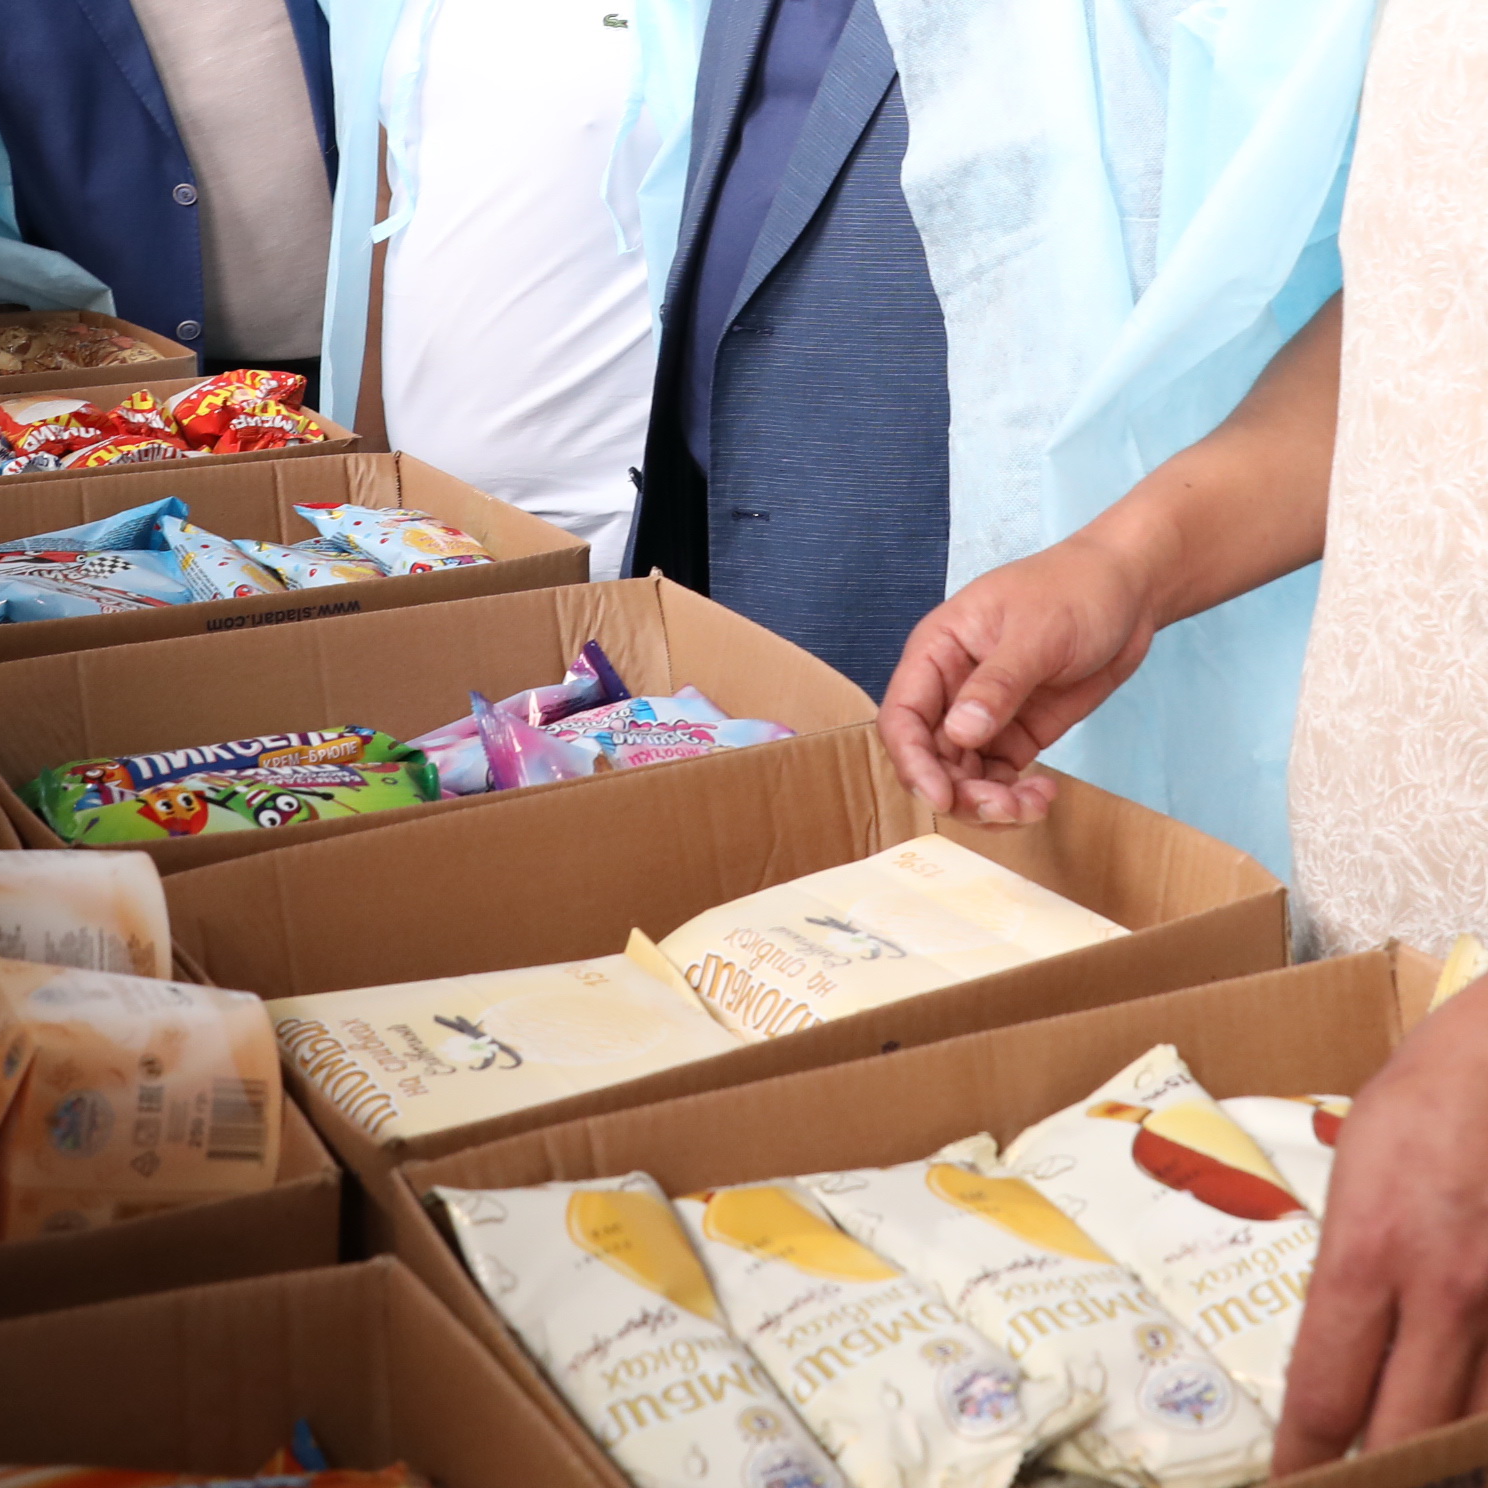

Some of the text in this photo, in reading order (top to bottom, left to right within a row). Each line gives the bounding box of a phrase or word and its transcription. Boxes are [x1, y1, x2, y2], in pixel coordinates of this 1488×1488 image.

[207, 601, 361, 631] www.sladari.com
[684, 954, 825, 1040] ЛОМБИР
[1189, 1224, 1318, 1300] ливках
